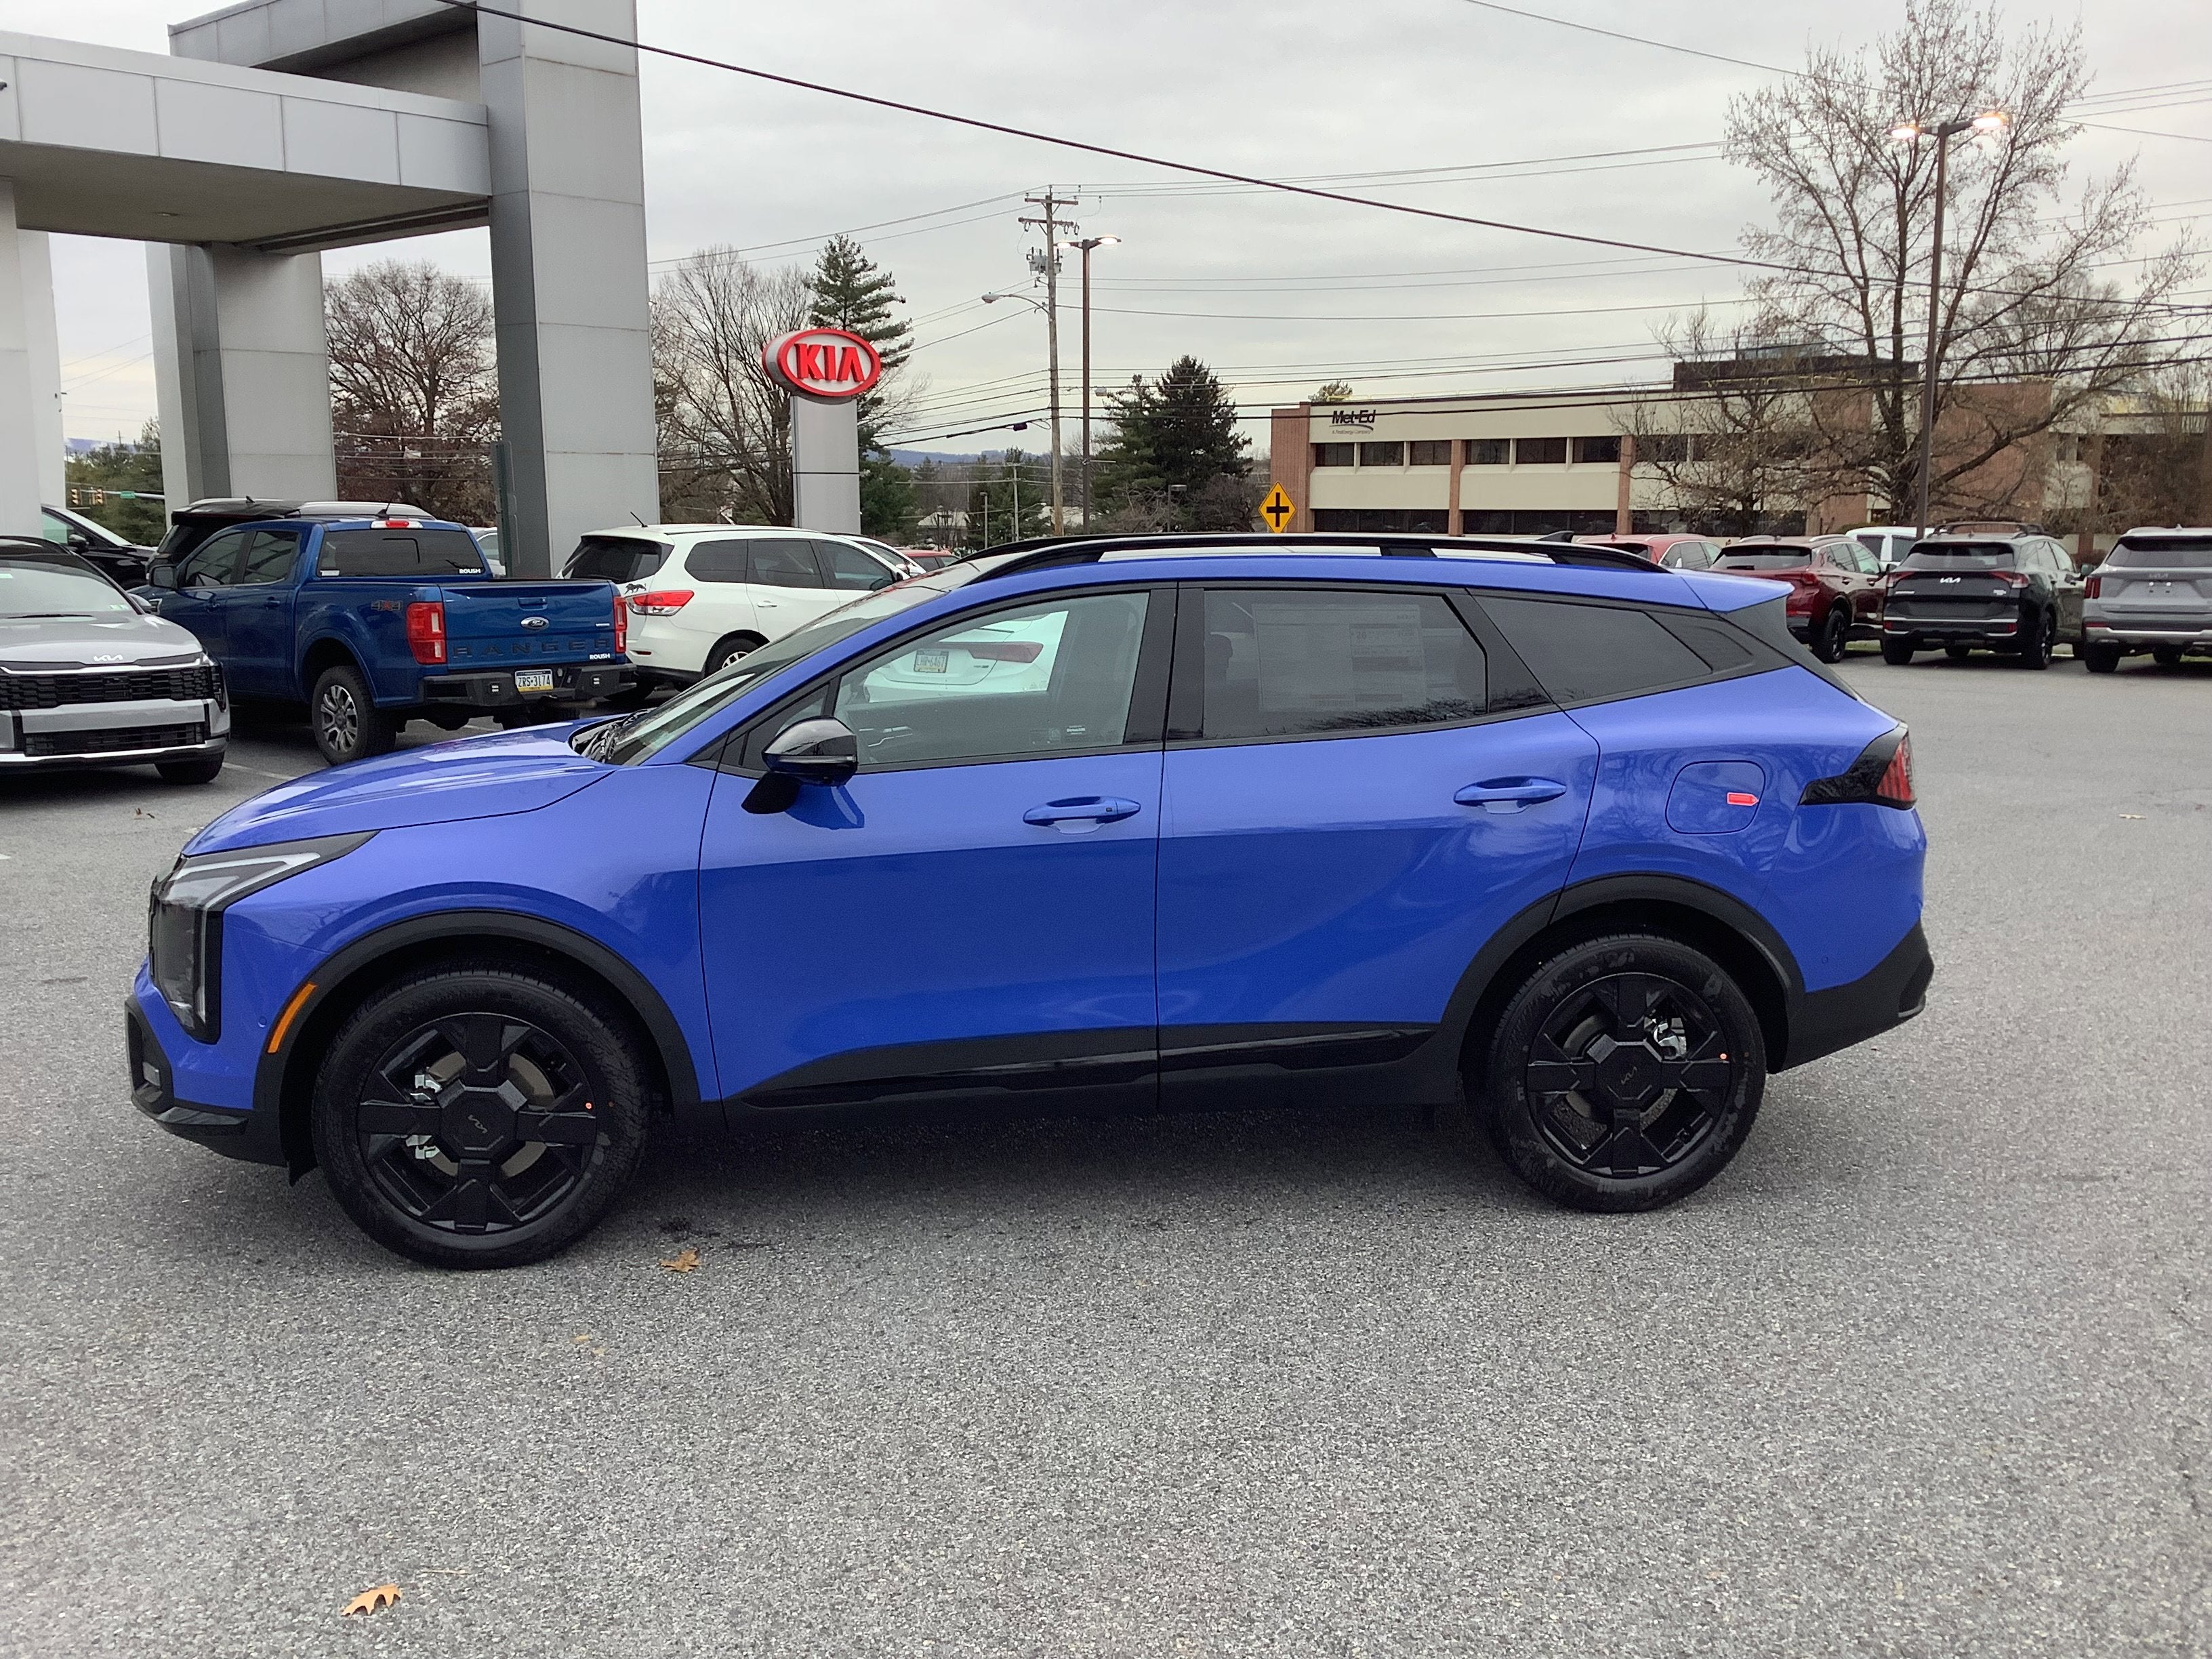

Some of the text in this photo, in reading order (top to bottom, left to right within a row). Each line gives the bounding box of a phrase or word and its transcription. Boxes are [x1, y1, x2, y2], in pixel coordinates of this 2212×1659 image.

[794, 344, 864, 382] KIA
[1332, 409, 1376, 424] Met-Ed
[452, 639, 611, 659] RANGER
